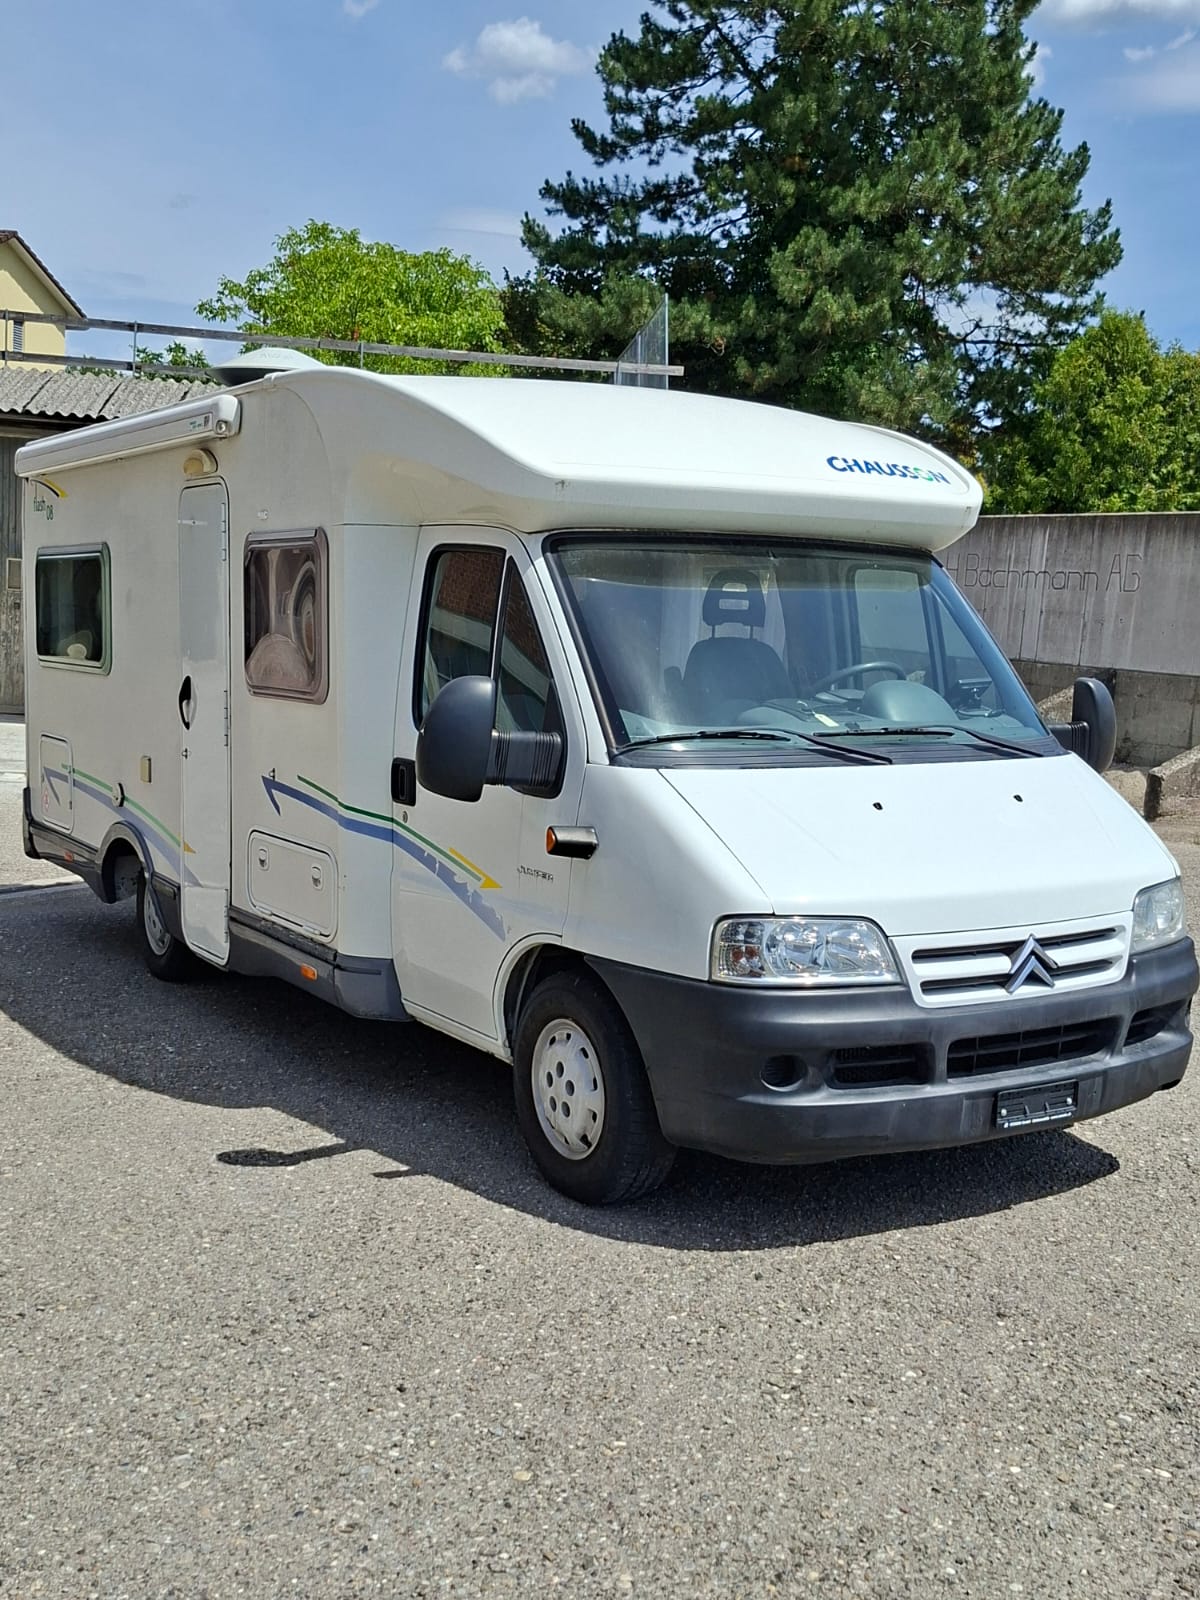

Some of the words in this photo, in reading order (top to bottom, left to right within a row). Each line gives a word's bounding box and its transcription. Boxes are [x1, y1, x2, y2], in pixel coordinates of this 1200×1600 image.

[826, 456, 951, 485] CHAUSSON
[964, 553, 1099, 591] Bachmann
[1105, 553, 1143, 593] AG
